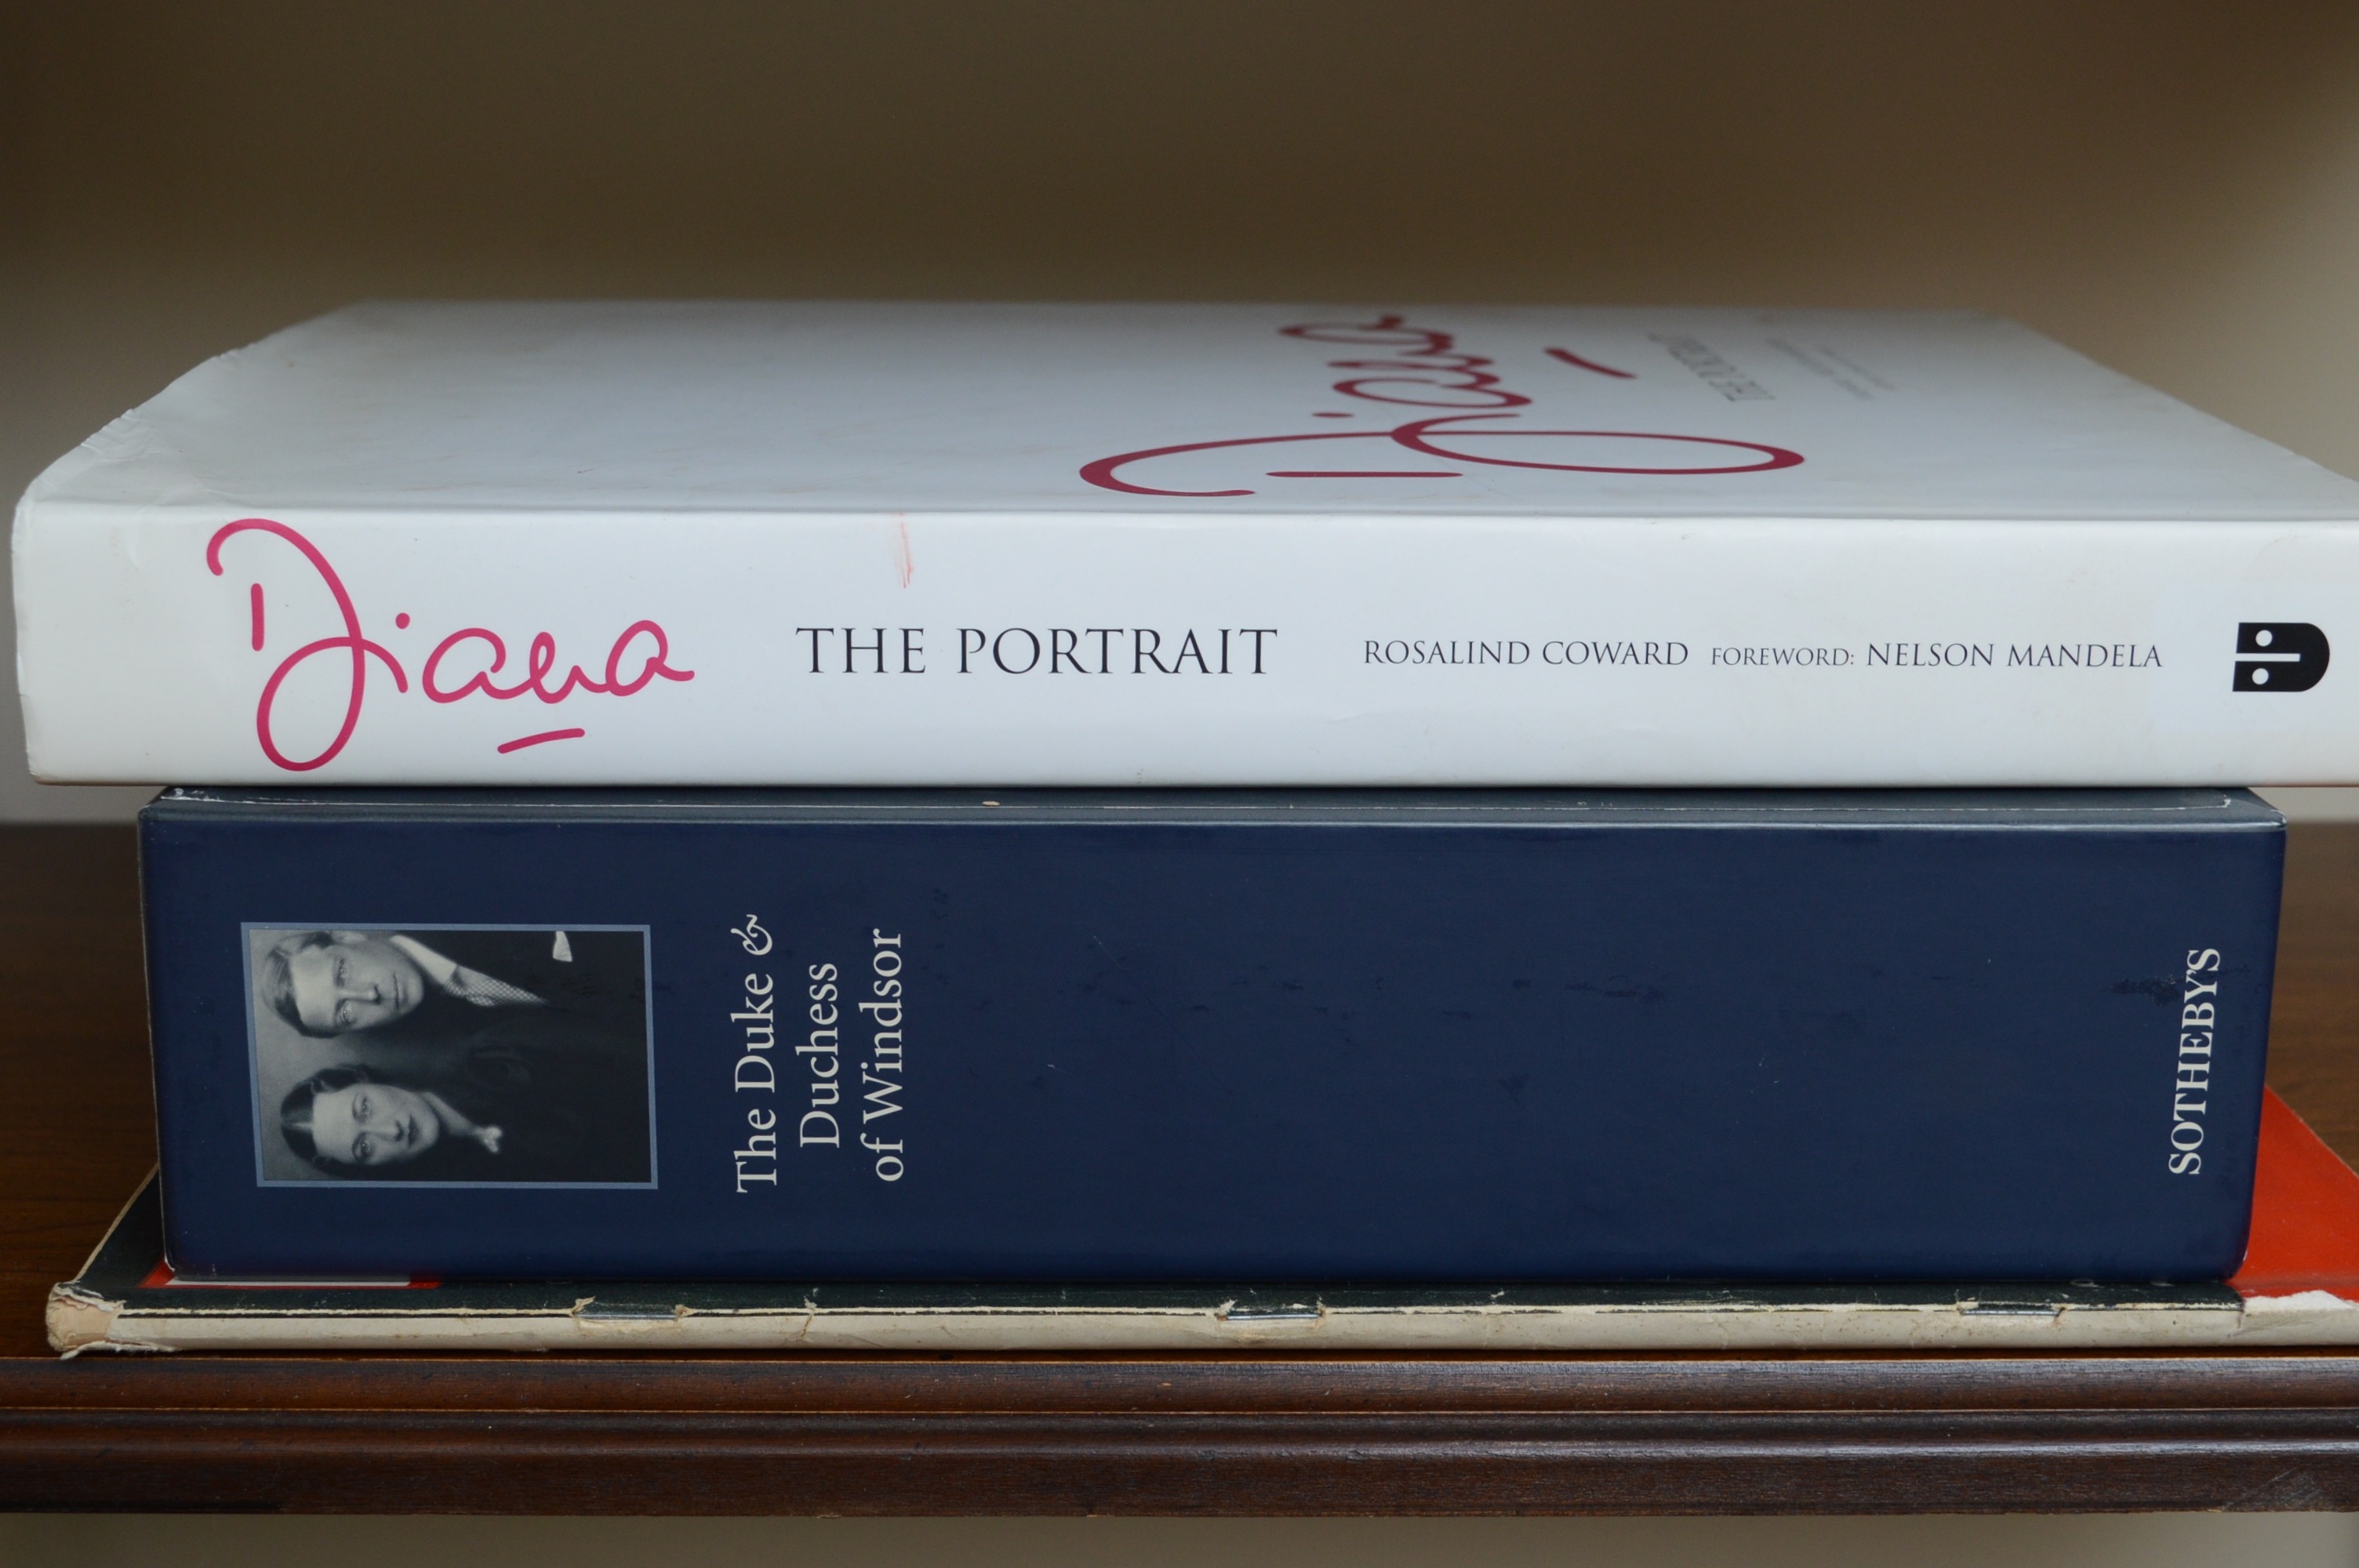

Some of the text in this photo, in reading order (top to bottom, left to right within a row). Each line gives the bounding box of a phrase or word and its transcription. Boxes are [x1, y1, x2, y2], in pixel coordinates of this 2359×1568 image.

[205, 517, 696, 772] Diana
[794, 626, 1278, 675] THE PORTRAIT
[1363, 639, 2163, 668] ROSALIND COWARD FOREWORD: NELSON MANDELA
[730, 913, 777, 1193] The Duke &
[794, 963, 840, 1149] Duchess
[858, 927, 904, 1181] of Windsor
[2168, 948, 2221, 1175] SOTHEBY'S
